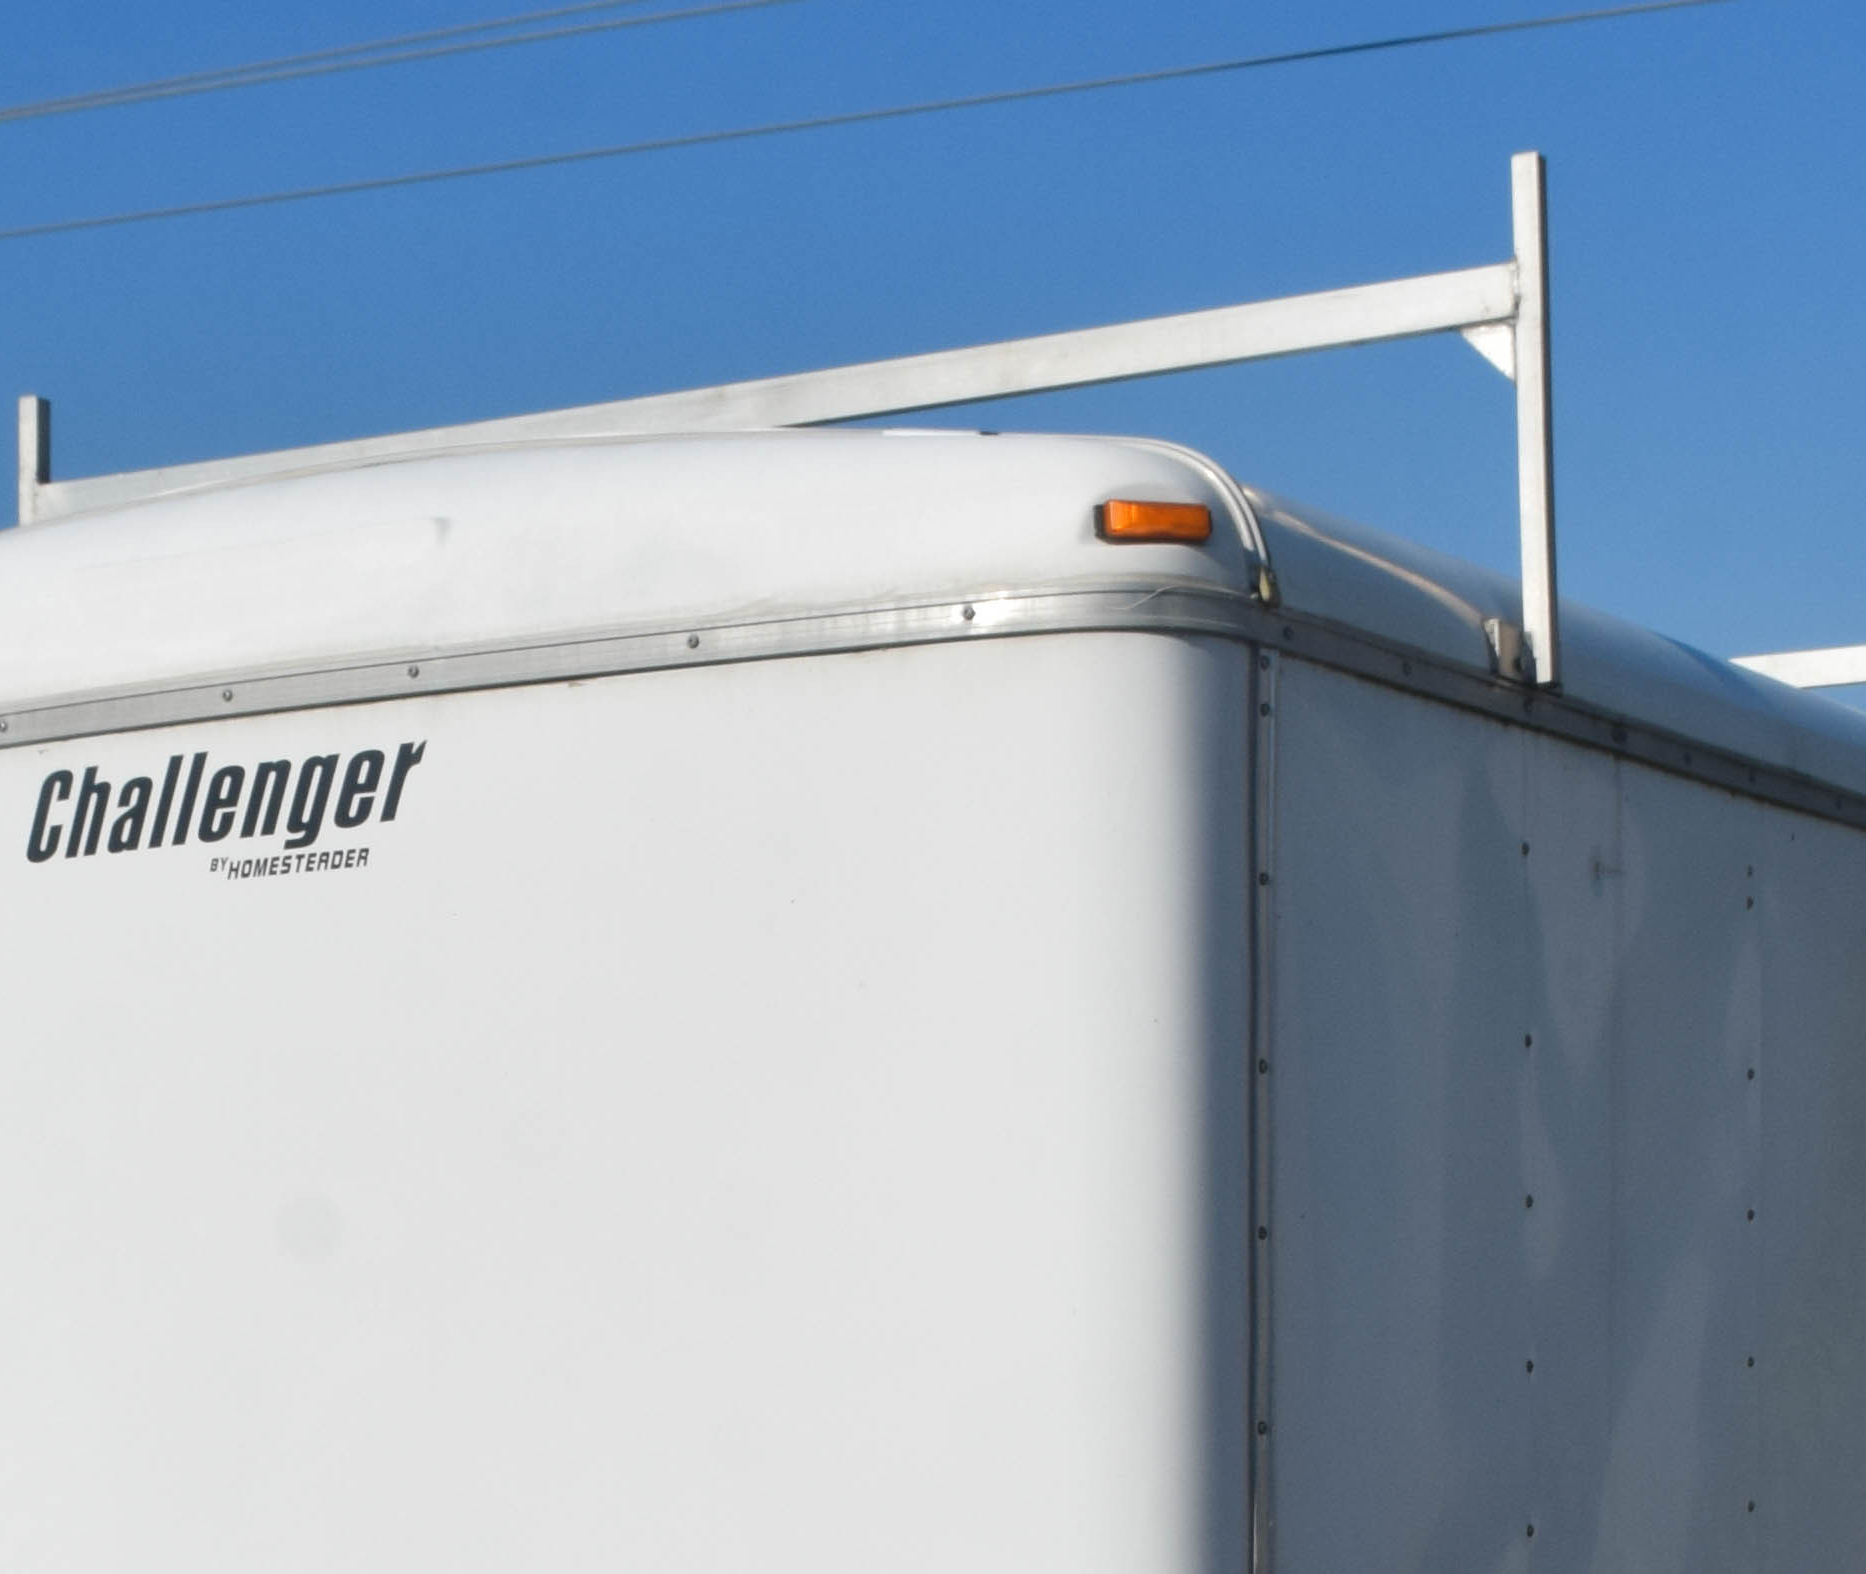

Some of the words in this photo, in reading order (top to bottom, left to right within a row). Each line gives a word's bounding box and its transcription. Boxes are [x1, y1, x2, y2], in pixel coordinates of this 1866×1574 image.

[25, 739, 428, 864] Challenger
[210, 857, 228, 872] BY
[227, 848, 370, 880] HOMESTEADER
